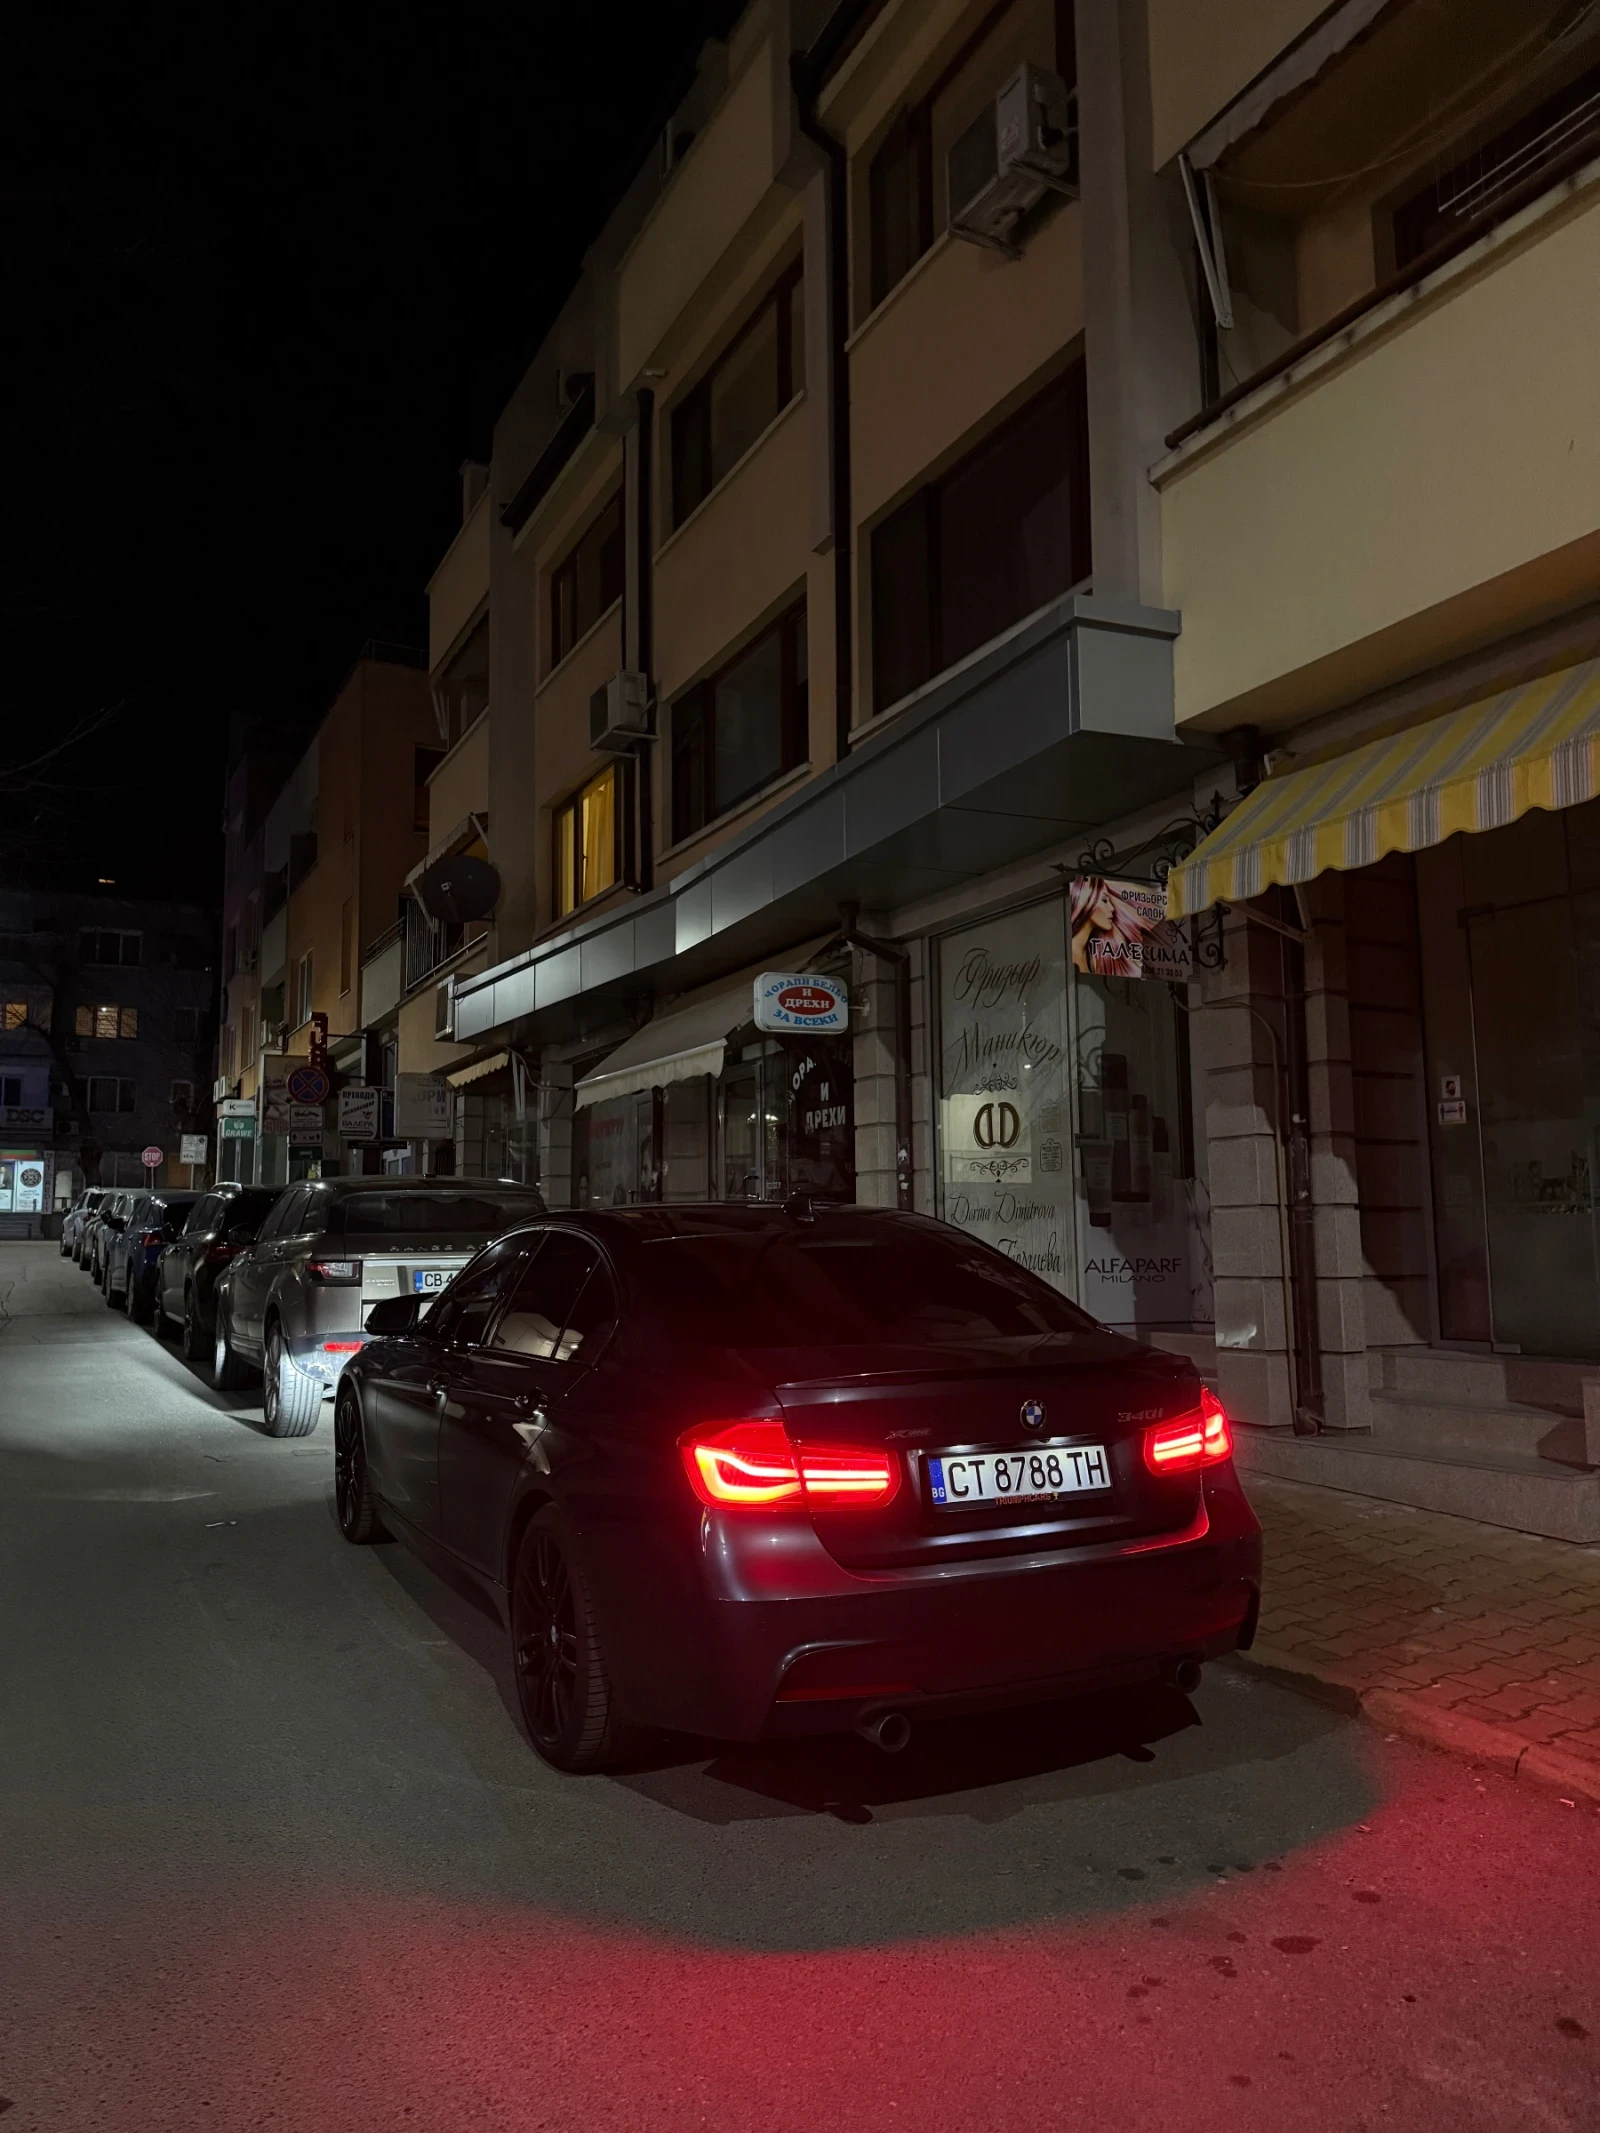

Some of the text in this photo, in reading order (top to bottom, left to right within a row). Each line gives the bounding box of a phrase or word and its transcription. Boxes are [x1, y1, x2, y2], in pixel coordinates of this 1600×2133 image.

[1121, 890, 1168, 906] ФРИЗЬОРС
[765, 978, 848, 1003] ЧОРАПИ БЕЛЬО
[802, 988, 812, 997] И
[785, 998, 830, 1009] ДРЕХИ
[773, 1009, 839, 1026] ЗА ВСЕКИ
[821, 1082, 829, 1102] И
[6, 1108, 45, 1124] DSC
[805, 1105, 846, 1134] ДРЕХИ
[225, 1129, 253, 1137] GRAWE
[144, 1151, 161, 1163] STOP
[1084, 1258, 1182, 1274] ALFAPARF
[425, 1273, 443, 1288] CB
[1101, 1274, 1166, 1284] MILANO
[949, 1451, 1106, 1497] CT 8788 TH
[931, 1487, 945, 1499] BG
